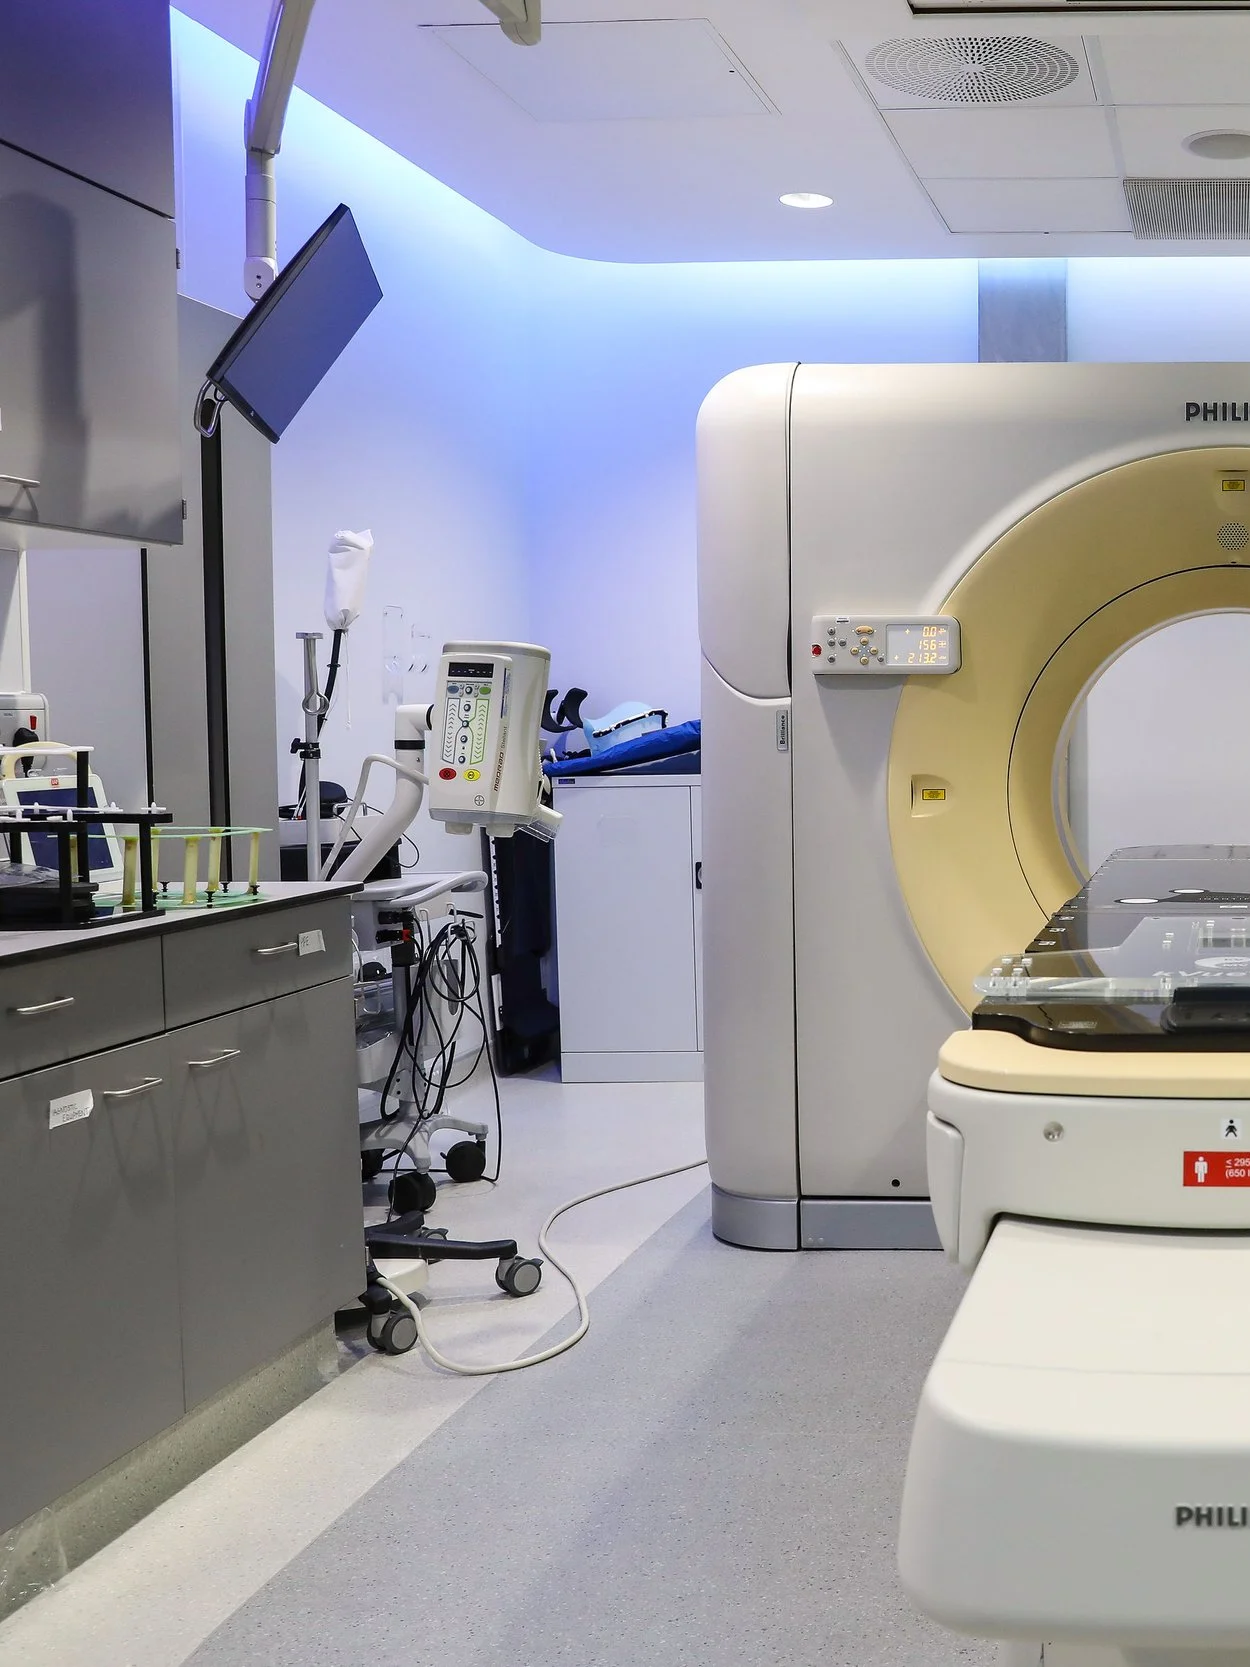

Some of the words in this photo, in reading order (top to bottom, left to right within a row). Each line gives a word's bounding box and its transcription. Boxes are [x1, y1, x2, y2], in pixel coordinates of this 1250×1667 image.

[919, 639, 937, 650] 156
[1234, 1158, 1250, 1167] 295
[1225, 1169, 1246, 1179] (650
